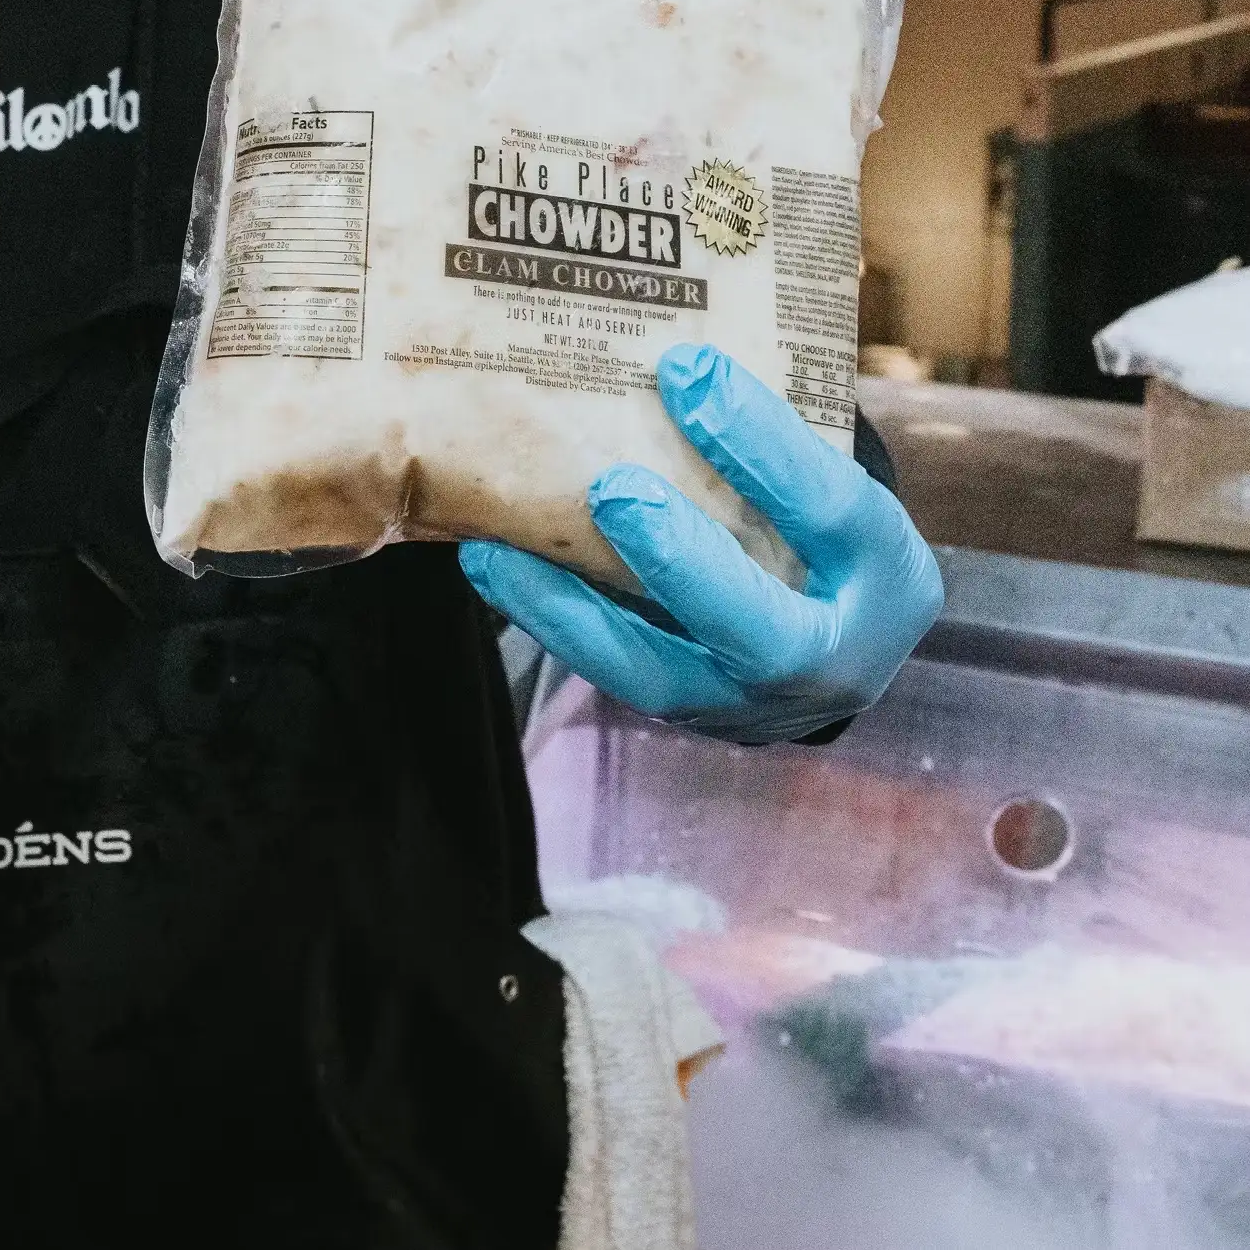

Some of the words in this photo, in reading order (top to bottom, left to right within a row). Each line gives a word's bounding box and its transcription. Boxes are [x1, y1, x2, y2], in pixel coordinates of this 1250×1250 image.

[291, 116, 328, 131] Facts
[292, 132, 314, 142] (227g)
[547, 134, 560, 143] KEEP
[261, 152, 273, 161] PER
[274, 150, 312, 160] CONTAINER
[501, 136, 537, 153] Serving
[539, 142, 584, 158] America's
[586, 148, 605, 161] Best
[607, 152, 650, 167] Chowder
[290, 162, 318, 171] Calories
[337, 162, 348, 170] Fat
[350, 162, 364, 171] 250
[344, 175, 363, 184] Value
[473, 145, 549, 191] Pike
[578, 161, 675, 210] Place
[346, 186, 362, 195] 48%
[705, 174, 754, 212] AWARD
[695, 193, 752, 239] WINNING
[345, 220, 361, 229] 17%
[474, 190, 678, 263] CHOWDER
[348, 242, 360, 251] 7%
[343, 253, 360, 262] 20%
[453, 250, 540, 282] CLAM
[552, 264, 703, 305] CHOWDER
[345, 298, 358, 306] 0%
[473, 285, 495, 299] There
[506, 290, 536, 306] nothing
[537, 293, 546, 305] to
[547, 294, 561, 307] add
[562, 297, 571, 309] to
[587, 302, 642, 320] award-winning
[644, 307, 677, 323] chowder!
[245, 308, 258, 317] 8%
[344, 310, 357, 318] 0%
[238, 322, 255, 332] Daily
[256, 322, 279, 331] Values
[506, 306, 535, 323] JUST
[541, 311, 571, 327] HEAT
[605, 318, 647, 338] SERVE!
[231, 333, 246, 341] diet.
[247, 332, 263, 341] Your
[263, 332, 282, 342] daily
[307, 335, 324, 344] may
[325, 335, 335, 343] be
[336, 335, 361, 345] higher
[544, 333, 558, 345] NET
[560, 335, 575, 347] WT.
[577, 337, 587, 349] 32
[598, 339, 609, 352] OZ
[235, 343, 272, 352] depending
[302, 344, 328, 352] calorie
[329, 346, 354, 355] needs.
[507, 343, 560, 359] Manufactured
[561, 351, 572, 361] for
[573, 352, 590, 363] Pike
[591, 354, 610, 365] Place
[611, 357, 645, 369] Chowder
[777, 339, 785, 349] IF
[785, 341, 800, 352] YOU
[800, 343, 828, 357] CHOOSE
[828, 348, 836, 358] TO
[383, 350, 412, 363] Follow
[413, 354, 423, 364] us
[423, 355, 434, 365] on
[435, 356, 473, 370] Instagram
[539, 366, 572, 380] Facebook
[411, 343, 430, 354] 1530
[430, 345, 448, 356] Post
[449, 347, 472, 360] Alley,
[473, 350, 494, 361] Suite
[508, 354, 536, 366] Seattle,
[537, 357, 551, 367] WA
[573, 361, 591, 372] (206)
[792, 352, 834, 371] Microwave
[835, 362, 845, 371] on
[792, 365, 799, 374] 12
[822, 370, 829, 380] 16
[525, 375, 569, 390] Distributed
[569, 381, 580, 393] by
[580, 383, 607, 395] Carso's
[607, 386, 627, 397] Pasta
[791, 379, 799, 389] 30
[822, 384, 829, 394] 45
[786, 392, 803, 407] THEN
[804, 396, 818, 409] STIR
[824, 402, 840, 412] HEAT
[820, 411, 828, 421] 45
